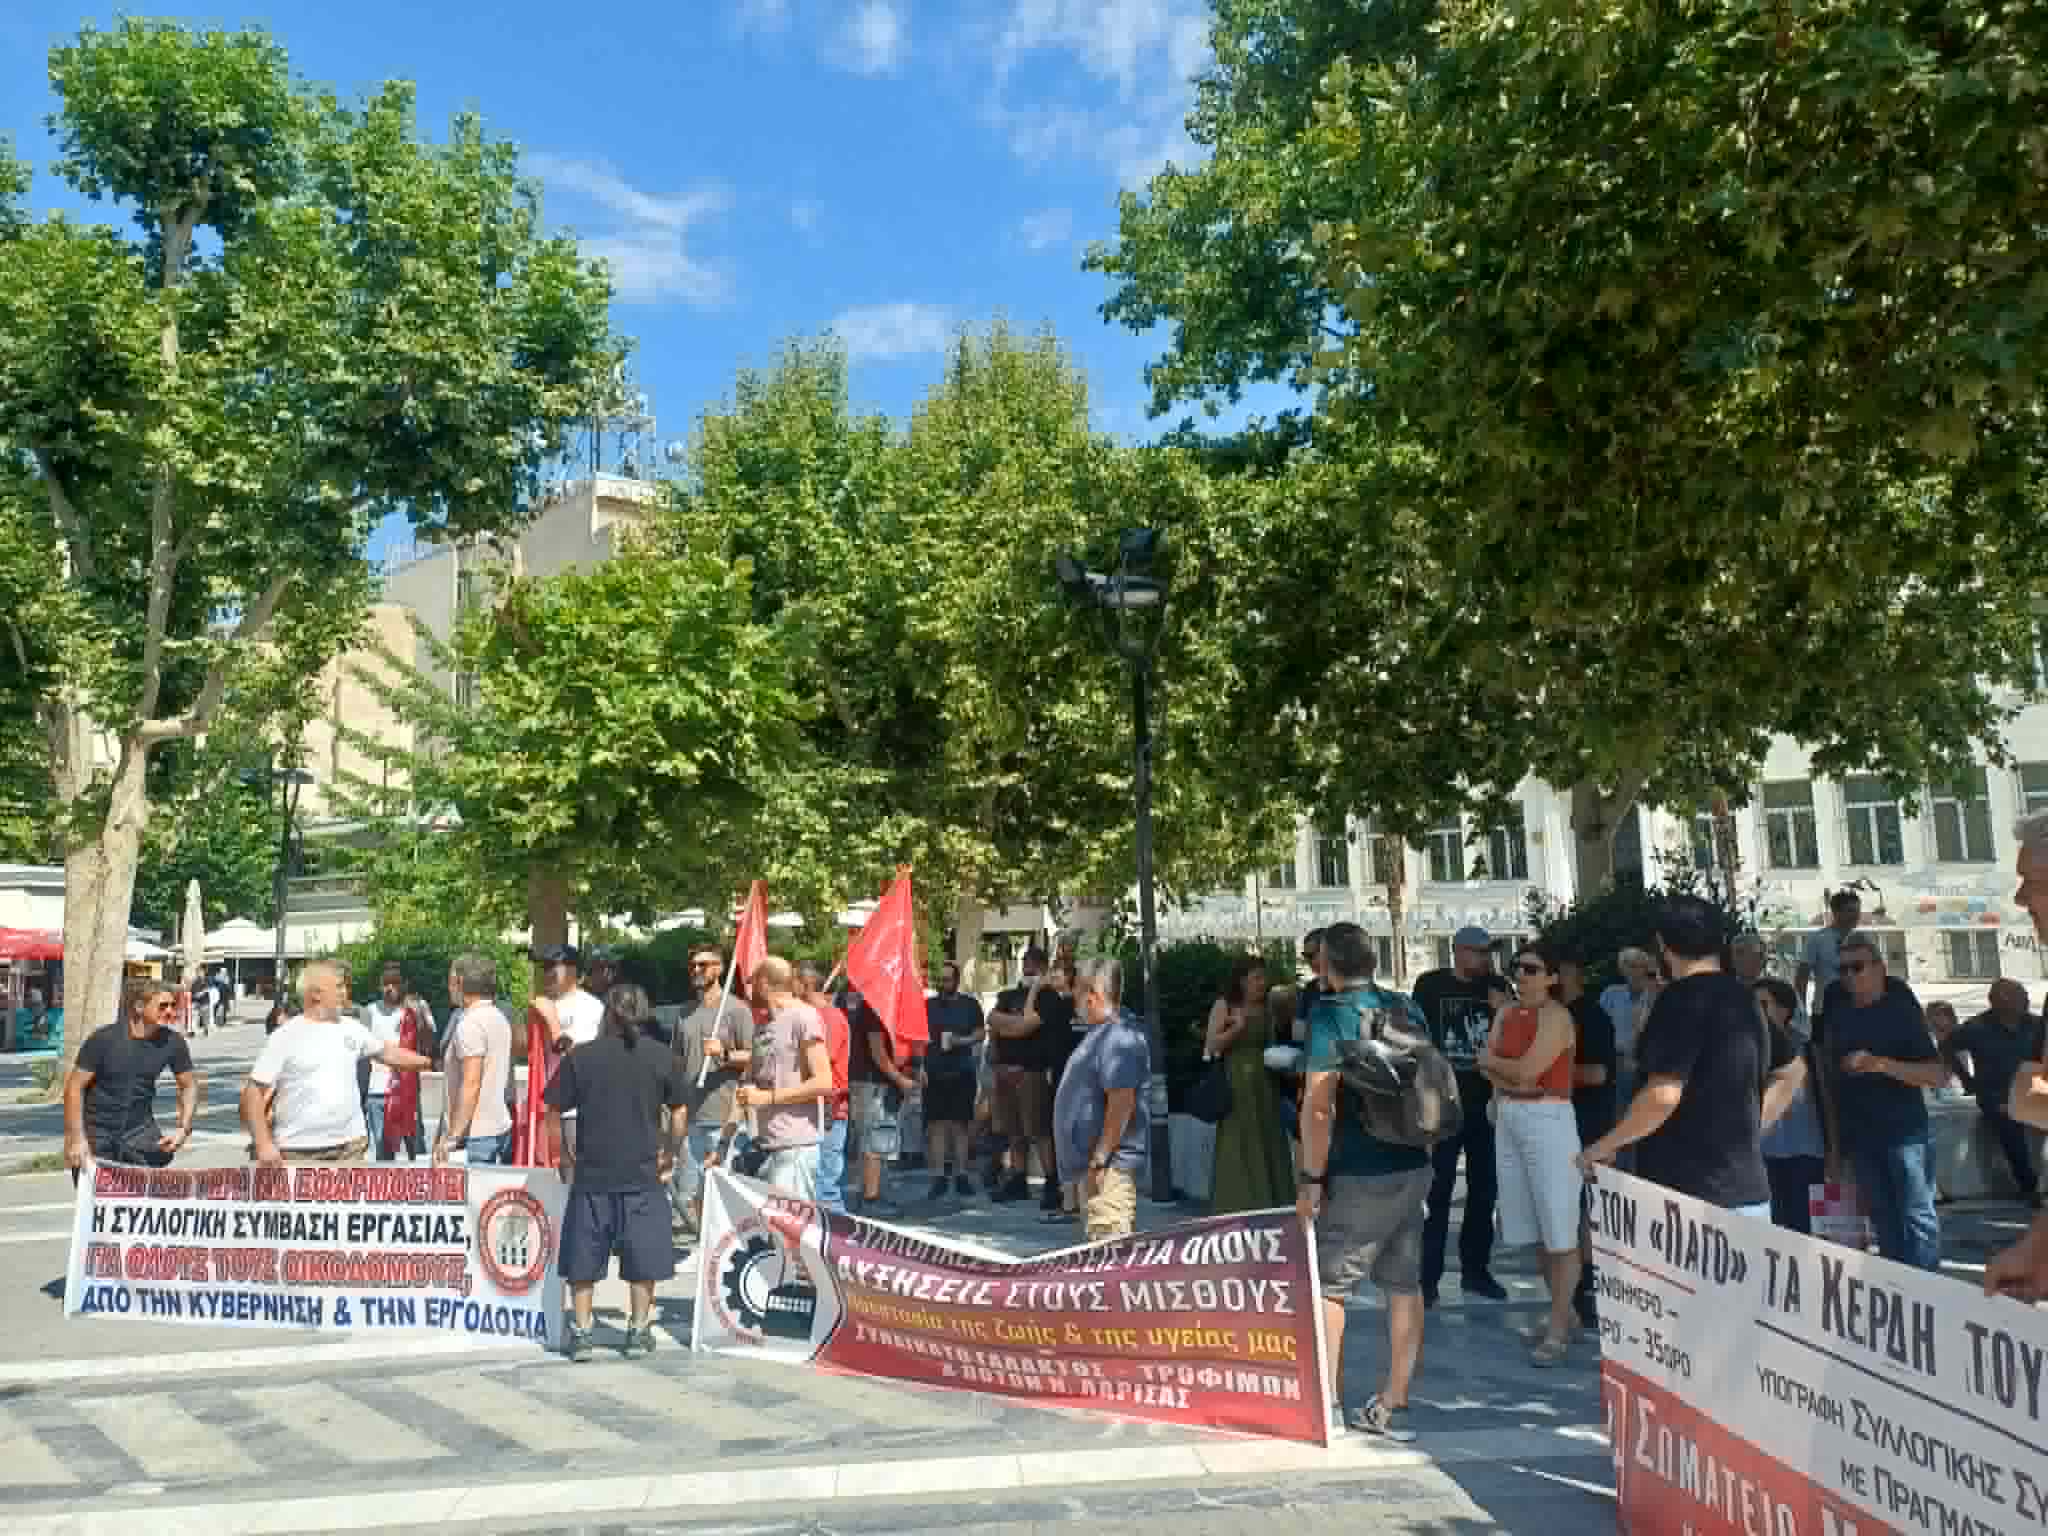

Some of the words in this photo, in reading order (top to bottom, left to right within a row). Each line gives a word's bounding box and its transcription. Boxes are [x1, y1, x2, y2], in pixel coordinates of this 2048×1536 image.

[92, 1206, 105, 1233] Η
[112, 1206, 227, 1238] ΣΥΛΛΟΓΙΚΗ
[232, 1210, 339, 1241] ΣΥΜΒΑΣΗ
[347, 1213, 471, 1250] ΕΡΓΑΣΙΑΣ,
[1180, 1227, 1288, 1265] ΟΛΟΥΣ
[85, 1242, 122, 1280] ΓΙΑ
[125, 1242, 209, 1282] ΟΛΟΥΣ
[212, 1246, 280, 1283] ΤΟΥΣ
[838, 1255, 998, 1305] ΑΥΞΗΣΕΙΣ
[1003, 1279, 1110, 1313] ΣΤΟΥΣ
[1119, 1277, 1298, 1317] ΜΙΣΘΟΥΣ
[81, 1282, 131, 1313] ΑΠΟ
[136, 1287, 183, 1317] ΤΗΝ
[189, 1289, 322, 1325] ΚΥΒΕΡΝΗΣΗ
[334, 1296, 352, 1326] &
[360, 1297, 416, 1326] ΤΗΝ
[425, 1298, 548, 1340] ΕΡΓΟΔΟΣΙΑ
[1650, 1199, 1747, 1285] «ΠΑΓΟ»
[1764, 1247, 1801, 1313] ΤΑ
[1819, 1253, 1937, 1377] ΚΕΡΔΗ
[1964, 1320, 2048, 1420] ΤΟΥ
[1247, 1329, 1297, 1361] μας
[1756, 1361, 1846, 1432] ΥΠΟΓΡΑΦΗ
[1850, 1397, 2006, 1505] ΣΥΛΛΟΓΙΚΗΣ
[1840, 1456, 1868, 1497] ΜΕ
